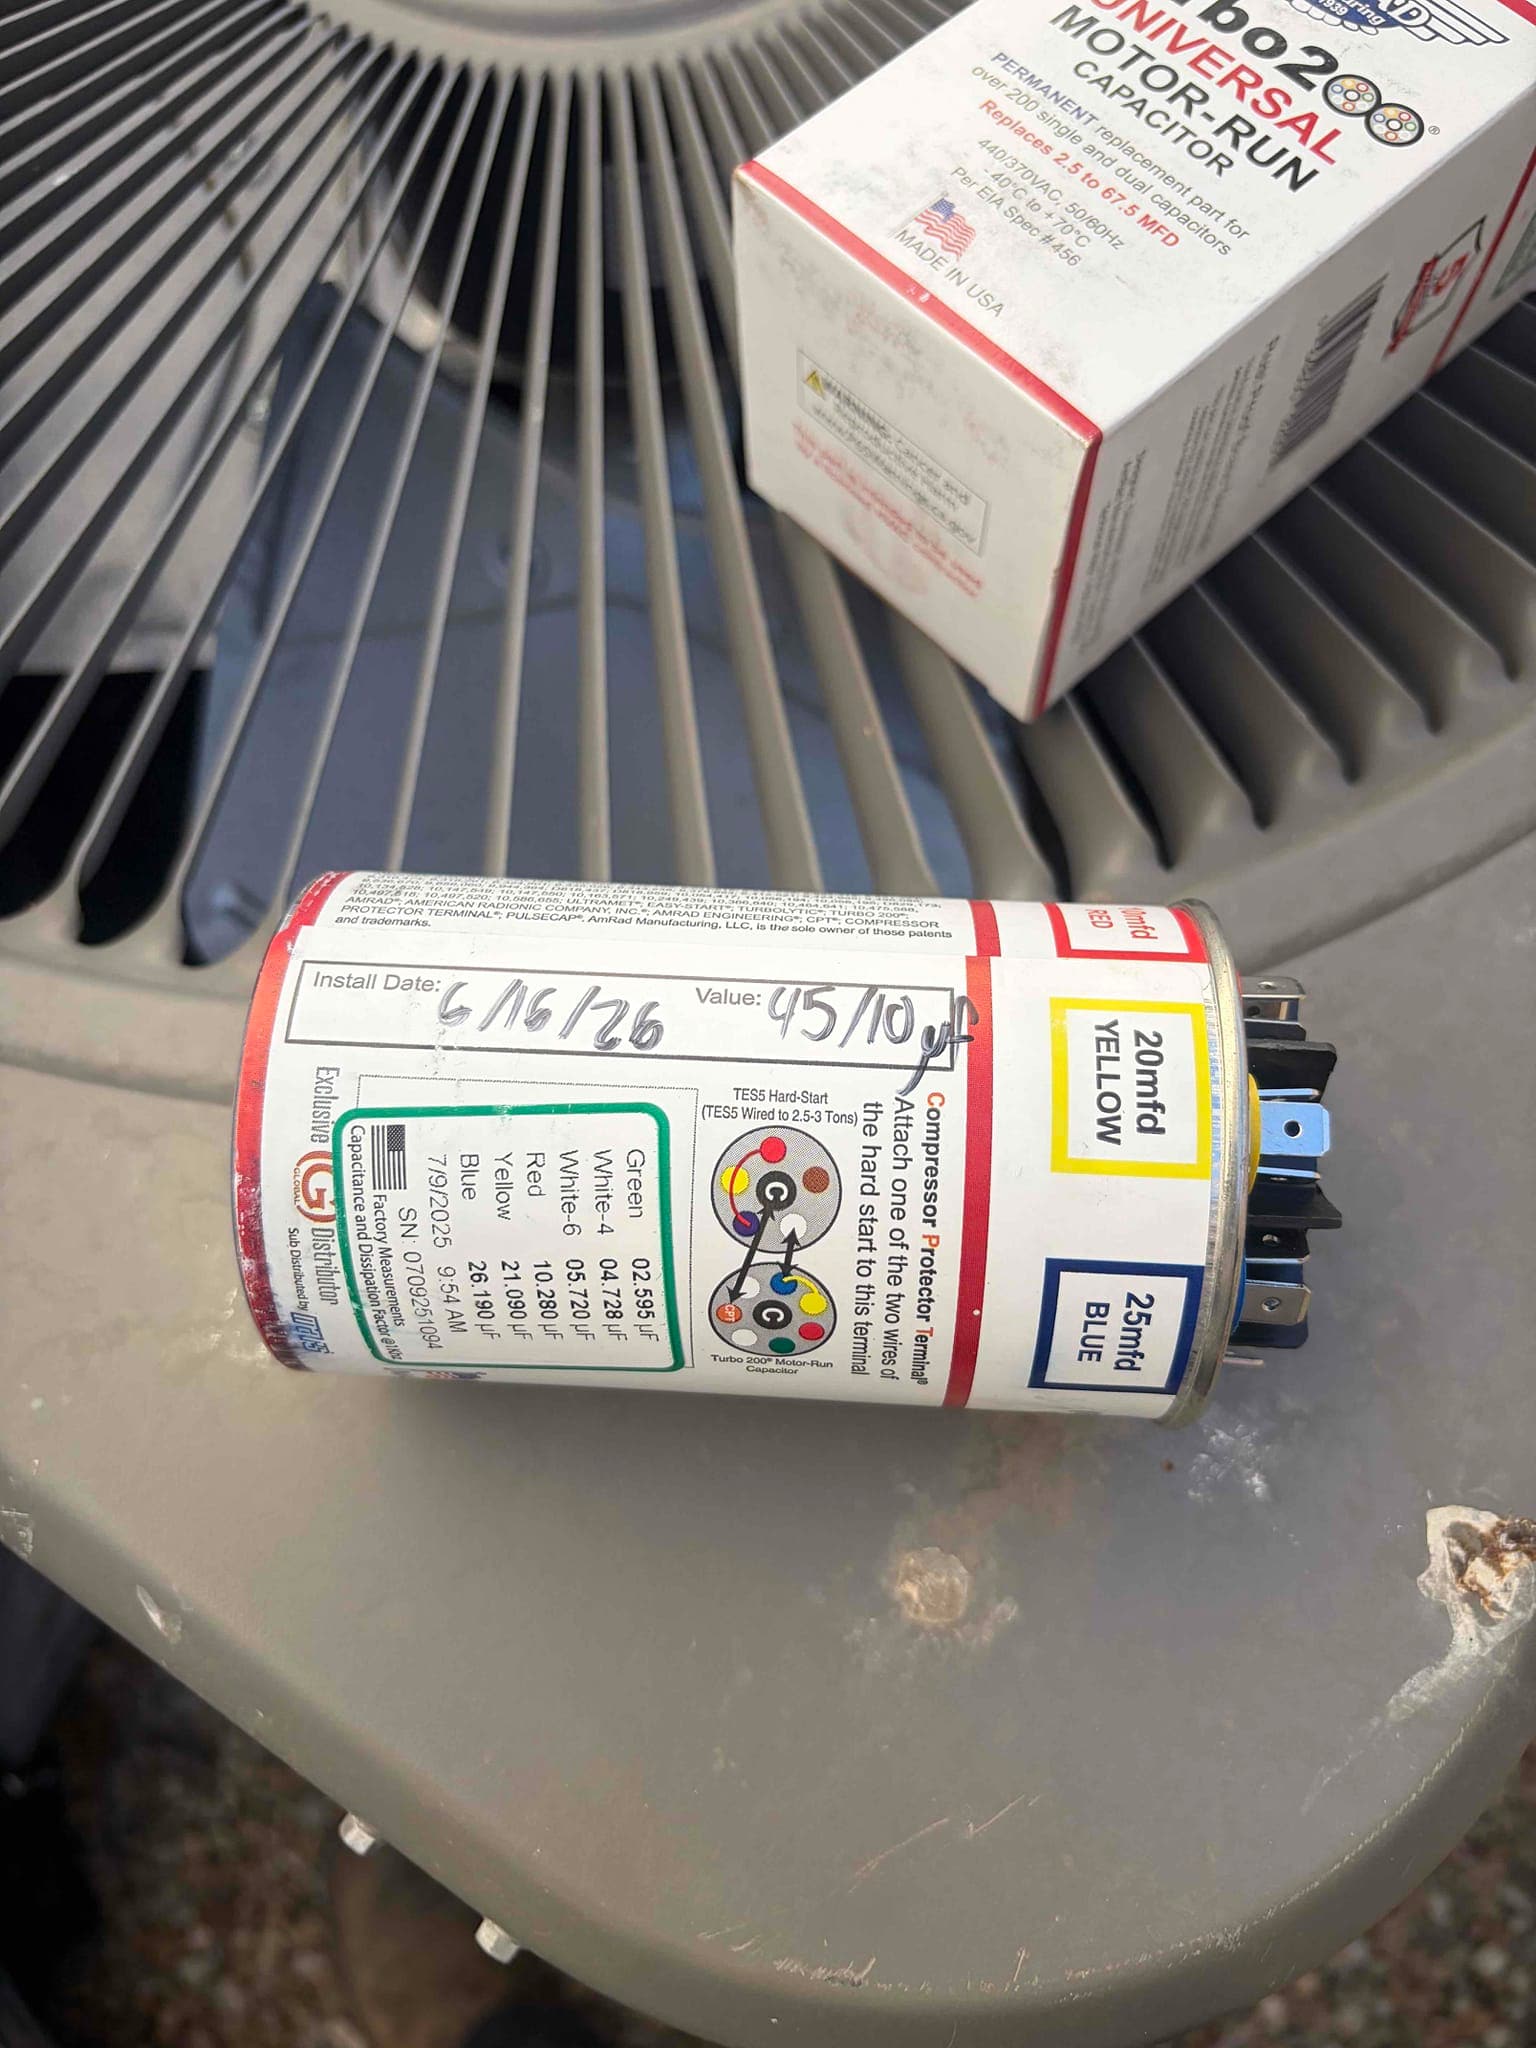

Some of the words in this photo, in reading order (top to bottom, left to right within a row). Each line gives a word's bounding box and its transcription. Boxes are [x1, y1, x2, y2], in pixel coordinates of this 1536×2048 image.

[1049, 4, 1320, 192] MOTOR-RUN
[1073, 60, 1235, 177] CAPACITOR
[971, 65, 1009, 91] over
[1005, 87, 1040, 112] 200
[1036, 109, 1084, 145] single
[1083, 142, 1117, 168] and
[1115, 166, 1152, 194] dual
[1150, 193, 1232, 256] capacitors
[991, 51, 1100, 127] PERMANENT
[1094, 124, 1193, 198] replacement
[1188, 194, 1228, 223] part
[1224, 217, 1250, 241] for
[977, 137, 1064, 206] 440/370VAC,
[1064, 202, 1126, 250] 50/60Hz
[979, 98, 1053, 156] Replaces
[1053, 151, 1084, 176] 2.5
[1080, 171, 1101, 190] to
[1101, 186, 1141, 217] 67.5
[1136, 213, 1181, 248] MFD
[950, 166, 979, 190] Per
[976, 185, 1004, 210] EIA
[1003, 205, 1041, 238] Spec
[1026, 197, 1042, 213] to
[894, 229, 949, 272] MADE
[945, 268, 970, 287] IN
[966, 283, 1005, 318] USA
[335, 916, 359, 924] and
[361, 917, 431, 927] trademarks.
[340, 905, 424, 916] PROTECTOR
[588, 915, 632, 925] AmRad
[636, 918, 722, 930] Manufacturing,
[725, 921, 753, 931] LLC,
[756, 923, 766, 931] is
[770, 924, 789, 932] the
[791, 925, 816, 933] sole
[858, 927, 870, 935] of
[873, 928, 905, 936] these
[908, 930, 953, 938] patents
[404, 899, 475, 908] AMERICAN
[477, 902, 542, 911] RADIONIC
[545, 904, 610, 914] COMPANY,
[652, 910, 700, 918] AMRAD
[845, 918, 939, 928] COMPRESSOR
[830, 910, 875, 918] TURBO
[313, 970, 376, 991] Install
[383, 974, 441, 993] Date:
[695, 986, 762, 1007] Value:
[310, 1066, 341, 1144] Exclusive
[733, 1087, 766, 1101] TES5
[768, 1089, 828, 1104] Hard-Start
[1094, 1018, 1122, 1146] YELLOW
[1133, 1029, 1166, 1135] 20mfd
[701, 1104, 738, 1120] (TES5
[741, 1107, 775, 1121] Wired
[778, 1109, 789, 1122] to
[792, 1109, 822, 1123] 2.5-3
[825, 1110, 858, 1127] Tons)
[863, 1101, 883, 1137] the
[892, 1096, 915, 1170] Attach
[347, 1124, 366, 1212] Capacitance
[460, 1153, 479, 1200] Blue
[526, 1151, 546, 1198] Red
[626, 1149, 646, 1218] Green
[860, 1145, 882, 1196] hard
[921, 1092, 945, 1228] Compressor
[293, 1167, 301, 1204] GLOBAL
[494, 1151, 514, 1221] Yellow
[559, 1149, 582, 1236] White-6
[593, 1149, 615, 1235] White-4
[765, 1184, 788, 1201] C
[890, 1178, 907, 1220] one
[288, 1227, 300, 1247] Sub
[355, 1215, 369, 1240] and
[373, 1194, 388, 1244] Factory
[398, 1206, 418, 1244] SN:
[427, 1153, 452, 1248] 7/9/2025
[446, 1308, 468, 1333] AM
[857, 1204, 878, 1252] start
[889, 1228, 909, 1250] of
[290, 1250, 306, 1300] Distributed
[311, 1227, 343, 1305] Distributor
[358, 1244, 380, 1307] Dissipation
[379, 1247, 405, 1327] Measurements
[468, 1260, 495, 1319] 26.190
[501, 1260, 527, 1319] 21.090
[533, 1260, 559, 1319] 10.280
[565, 1258, 590, 1319] 05.720
[599, 1258, 623, 1319] 04.728
[632, 1257, 655, 1319] 02.595
[856, 1258, 876, 1278] to
[886, 1255, 908, 1286] the
[916, 1234, 940, 1322] Protector
[298, 1299, 310, 1312] by
[372, 1309, 391, 1337] Factor
[403, 1251, 443, 1350] 0709251094
[725, 1304, 735, 1322] CPT
[762, 1308, 784, 1322] C
[854, 1283, 875, 1316] this
[884, 1293, 905, 1324] two
[851, 1321, 873, 1375] terminal
[881, 1329, 902, 1366] wires
[1077, 1301, 1110, 1363] BLUE
[1113, 1292, 1155, 1372] 25mfd
[710, 1354, 744, 1363] Turbo
[775, 1359, 833, 1368] Motor-Run
[746, 1366, 799, 1374] Capacitor
[880, 1369, 899, 1380] of
